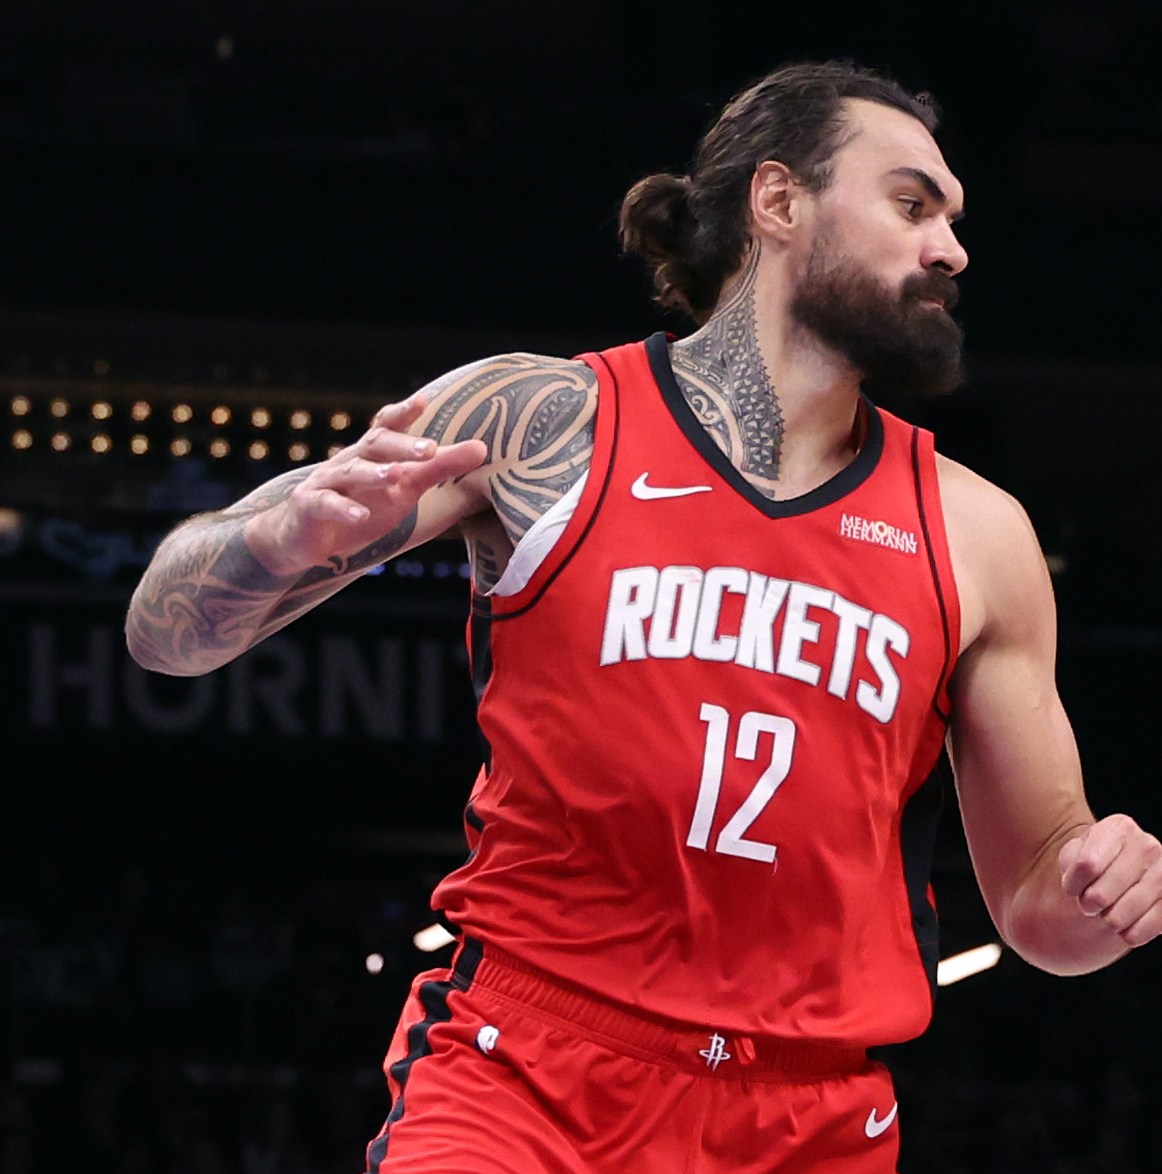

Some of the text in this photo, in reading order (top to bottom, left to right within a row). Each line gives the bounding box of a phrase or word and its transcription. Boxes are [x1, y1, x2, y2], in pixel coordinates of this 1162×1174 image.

[840, 526, 918, 554] HERMANN
[841, 513, 914, 545] MEMORIAL
[28, 620, 472, 742] HORNI
[599, 565, 911, 724] ROCKETS
[686, 702, 796, 863] 12
